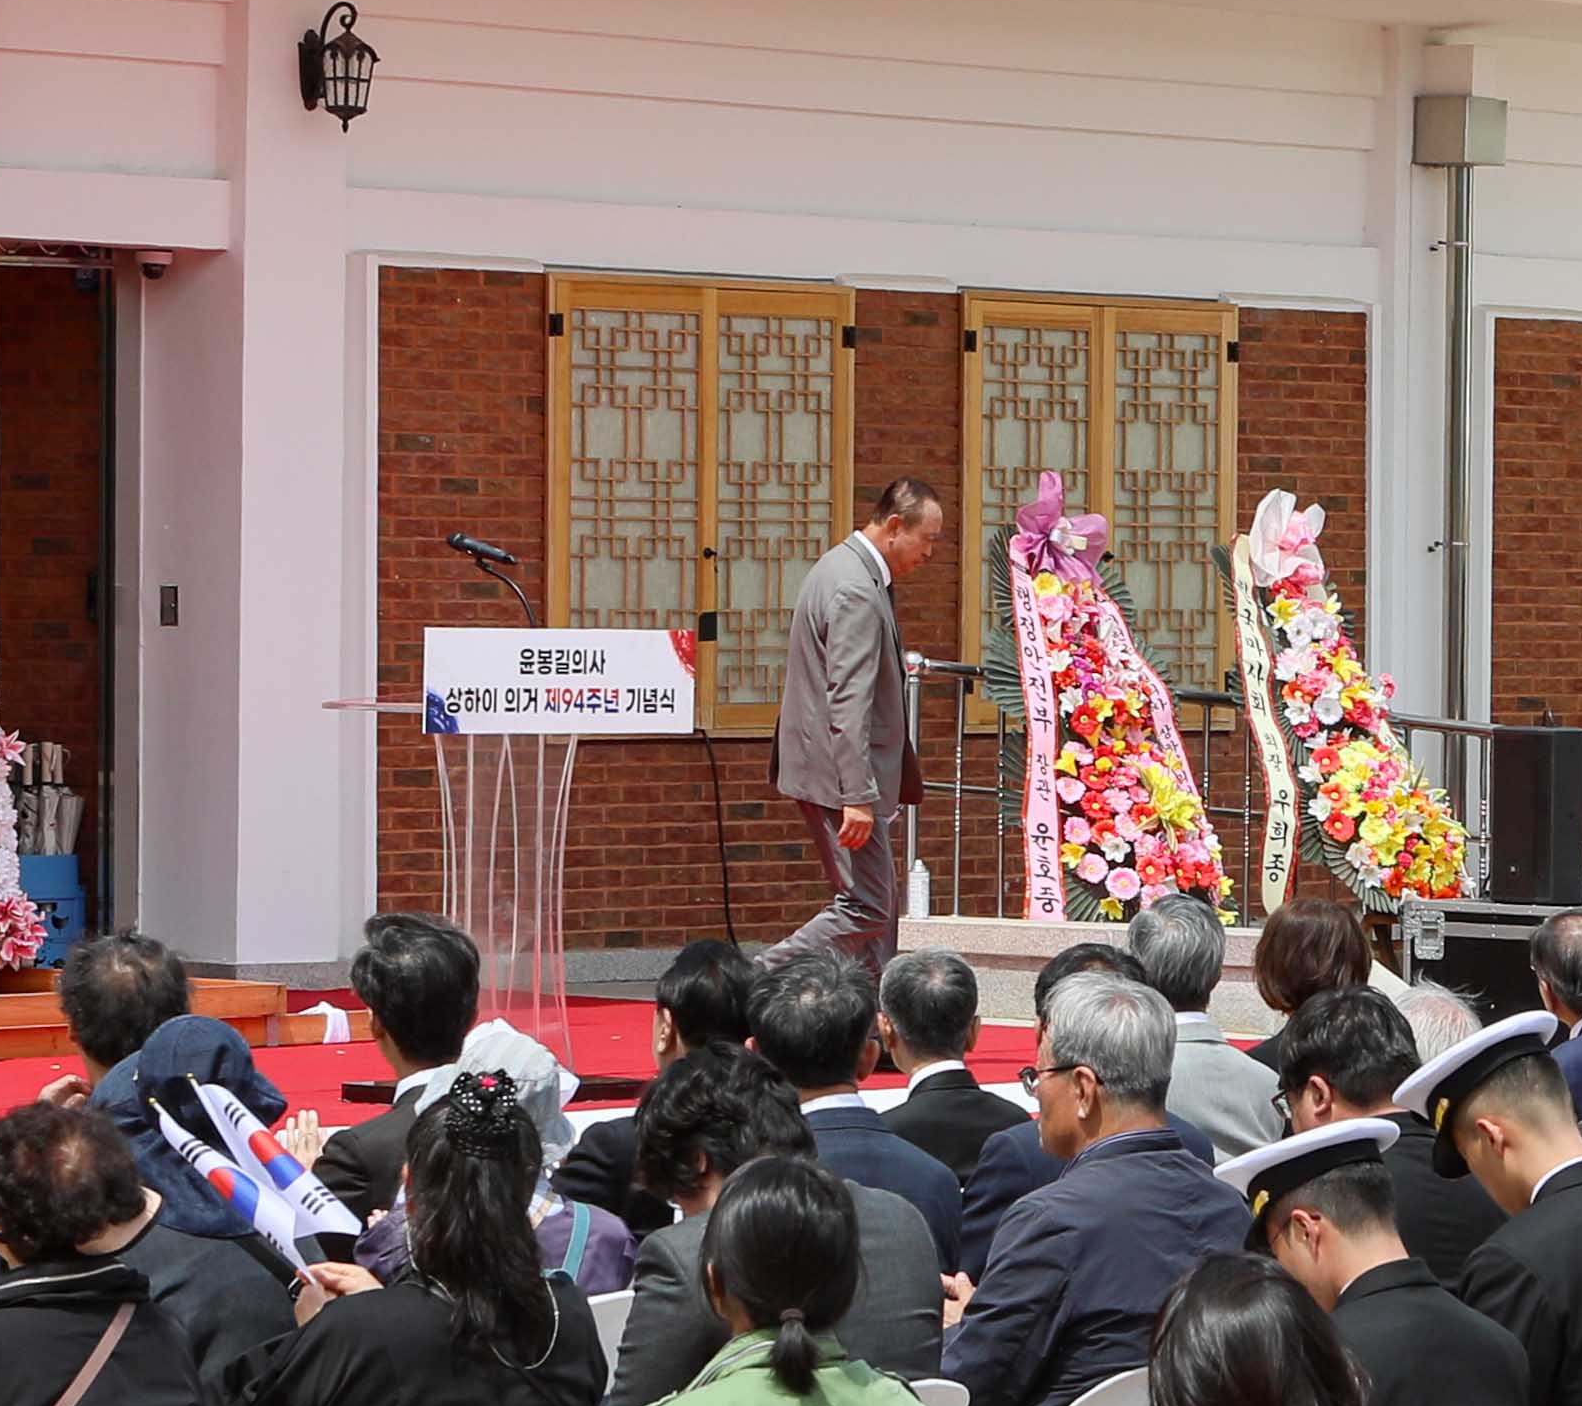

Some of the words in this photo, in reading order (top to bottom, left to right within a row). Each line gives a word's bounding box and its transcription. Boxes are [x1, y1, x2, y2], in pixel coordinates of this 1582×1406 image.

[519, 649, 606, 675] 윤봉길의사
[445, 687, 498, 715] 상하이
[504, 687, 539, 714] 의거
[544, 687, 620, 714] 제94주년
[625, 687, 676, 714] 기념식
[1035, 752, 1052, 802] 장관
[1265, 788, 1290, 883] 우희종
[1030, 822, 1061, 914] 윤호중
